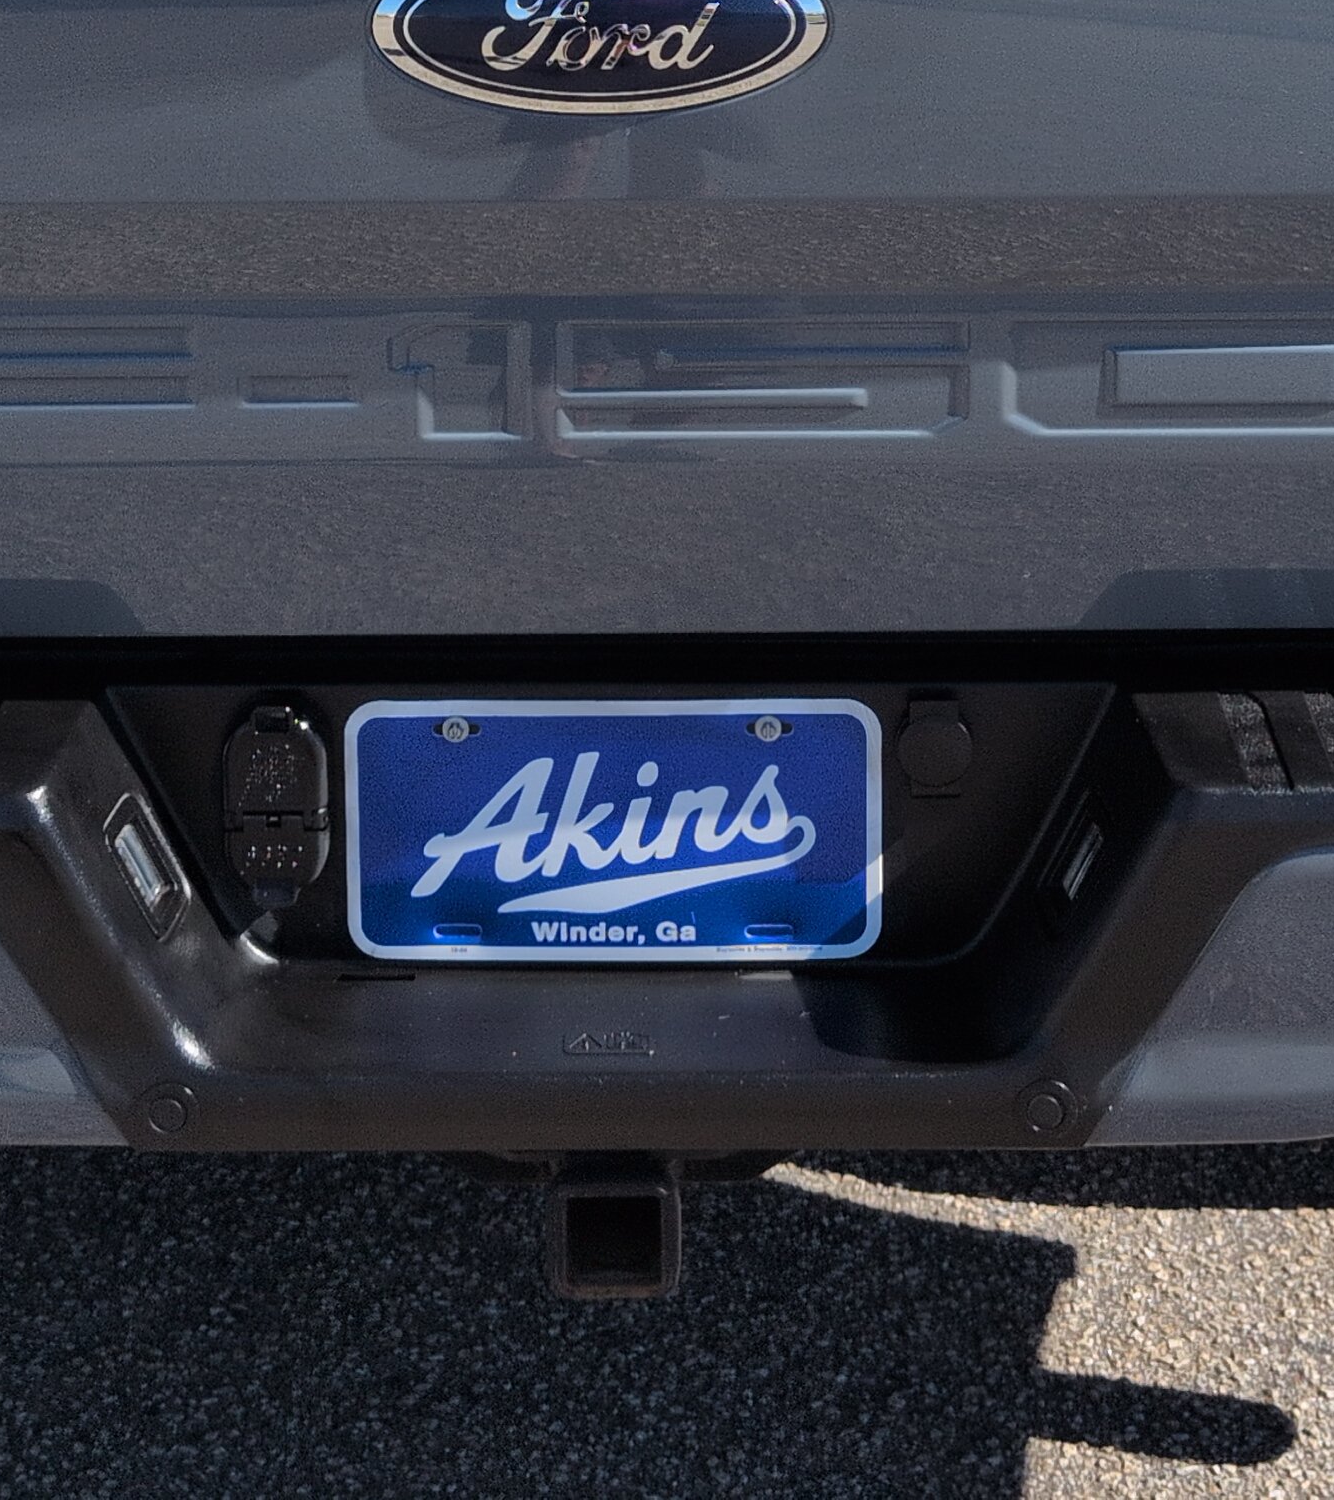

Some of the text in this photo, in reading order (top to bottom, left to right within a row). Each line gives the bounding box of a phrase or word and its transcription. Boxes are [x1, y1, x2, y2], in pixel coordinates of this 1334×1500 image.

[410, 751, 817, 913] Akins
[531, 920, 696, 945] Winder, Ga
